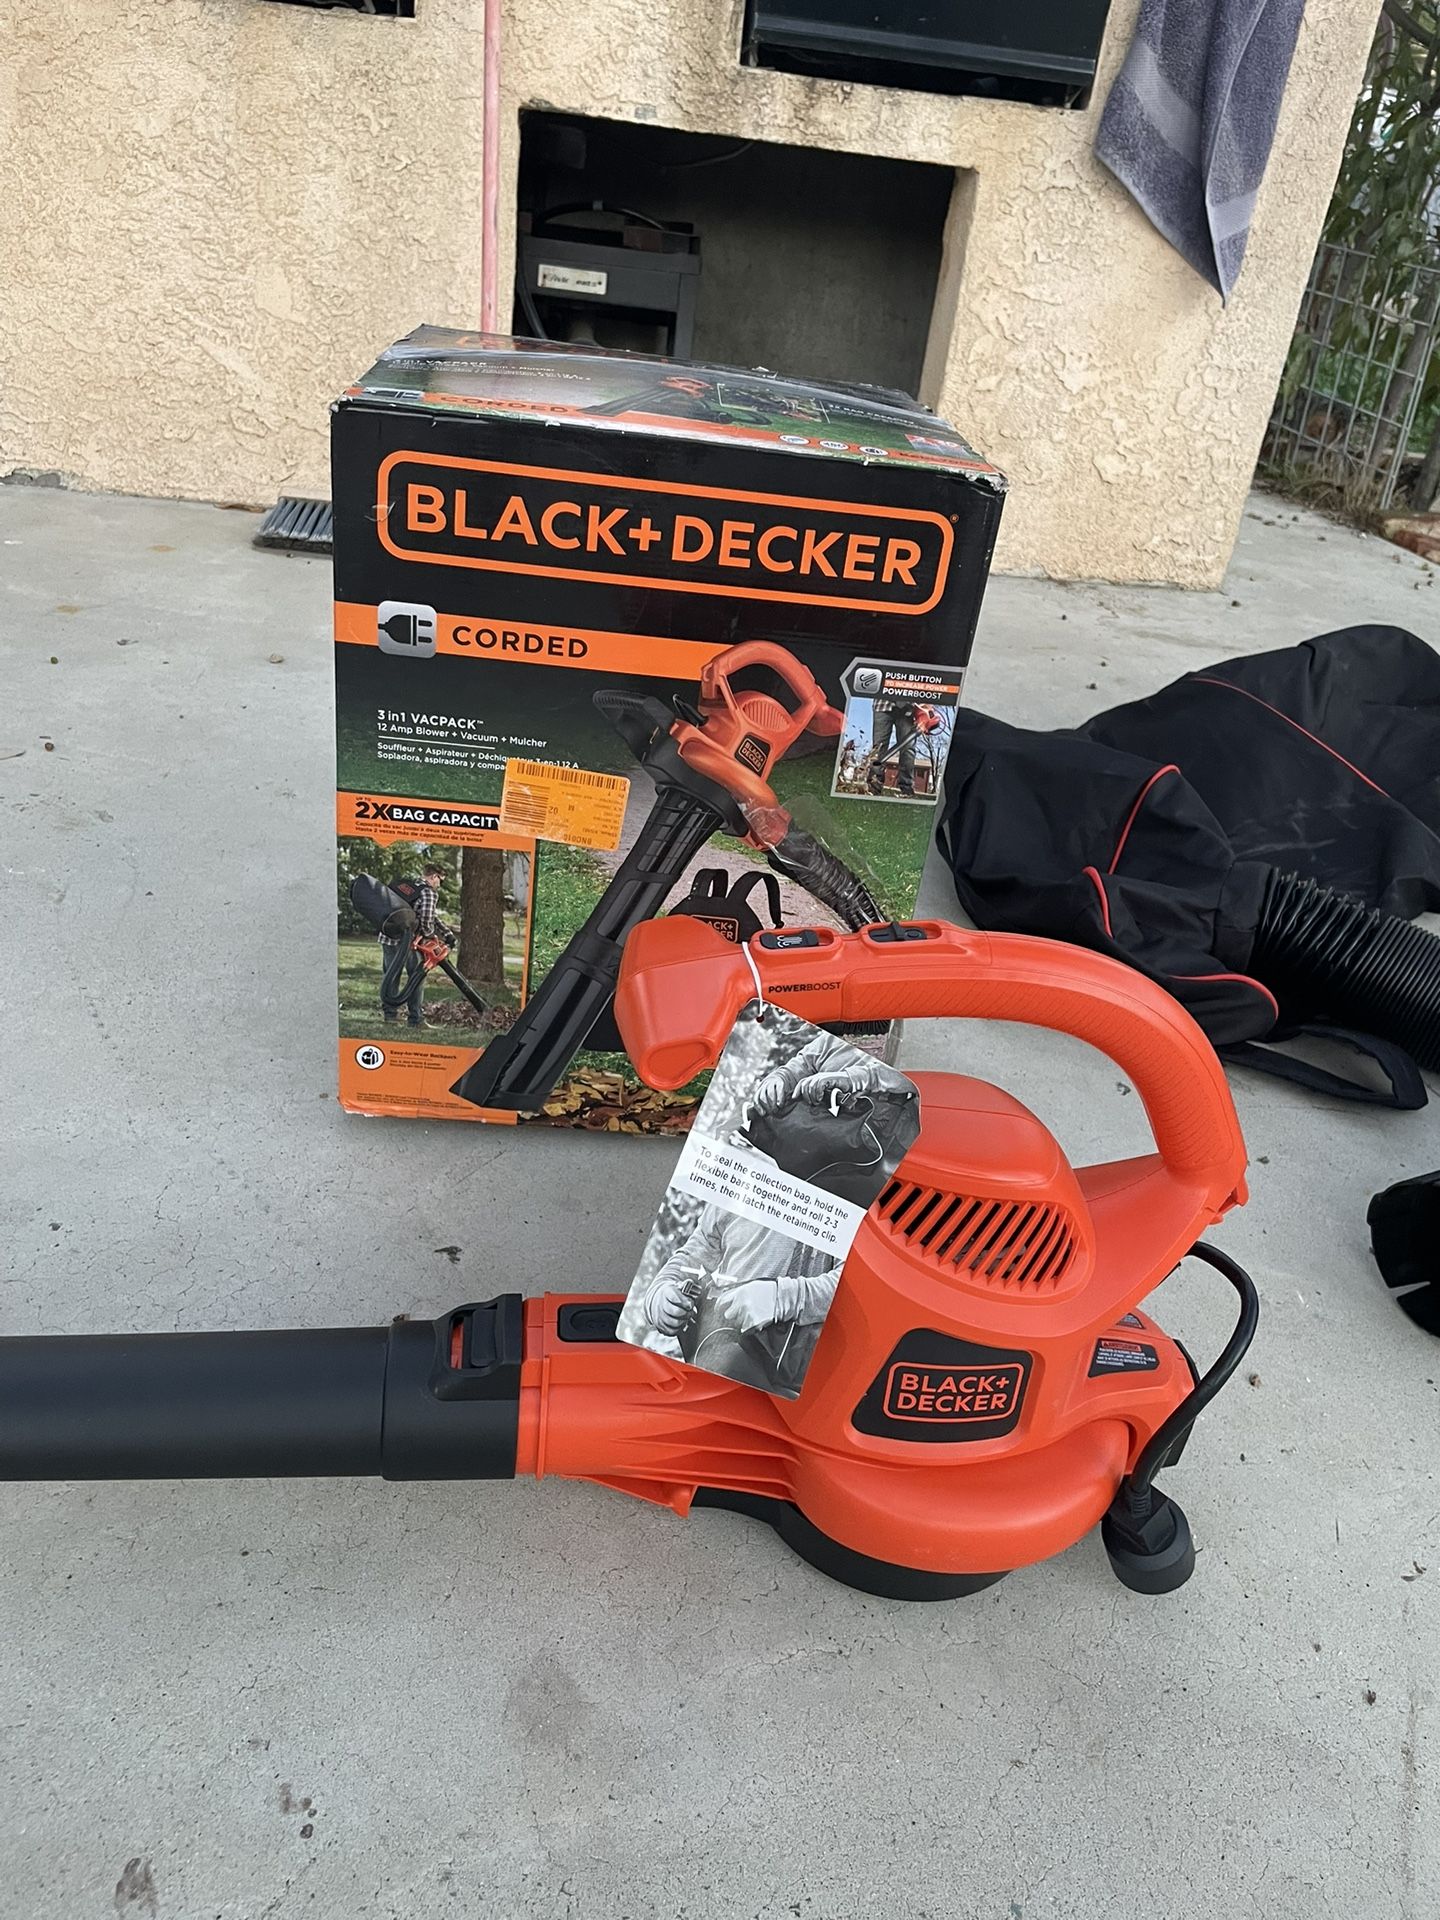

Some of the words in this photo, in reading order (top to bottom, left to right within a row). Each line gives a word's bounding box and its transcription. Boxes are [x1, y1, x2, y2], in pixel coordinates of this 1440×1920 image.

[406, 483, 922, 586] BLACK+DECKER
[452, 625, 588, 658] CORDED
[885, 672, 907, 680] PUSH
[908, 674, 942, 684] BUTTON
[882, 688, 942, 699] POWERBOOST
[377, 709, 385, 720] 3
[377, 722, 387, 732] 12
[390, 724, 413, 735] Amp
[416, 726, 449, 738] Blower
[460, 731, 498, 743] Vacuum
[509, 736, 548, 748] Mulcher
[377, 742, 416, 753] Souffleur
[425, 746, 469, 759] Aspirateur
[377, 751, 422, 764] Sopladora,
[424, 755, 468, 768] aspiradora
[469, 761, 475, 769] y
[477, 762, 507, 771] compa
[355, 801, 389, 820] 2X
[392, 808, 425, 821] BAG
[707, 921, 734, 930] ACK+
[768, 981, 842, 994] POWERBOOST
[700, 1146, 712, 1159] To
[713, 1154, 733, 1169] seal
[733, 1161, 748, 1175] the
[750, 1169, 793, 1195] collection
[794, 1188, 813, 1206] bag,
[814, 1196, 834, 1215] hold
[835, 1206, 849, 1220] the
[694, 1158, 729, 1182] flexible
[730, 1173, 751, 1191] bars
[752, 1183, 790, 1208] together
[791, 1200, 808, 1216] and
[808, 1208, 824, 1223] roll
[824, 1216, 839, 1229] 2-3
[689, 1171, 718, 1192] times,
[719, 1184, 741, 1201] then
[742, 1194, 766, 1213] latch
[767, 1204, 782, 1218] the
[782, 1212, 820, 1237] retaining
[821, 1230, 838, 1245] clip.
[900, 1373, 1010, 1393] BLACK+
[897, 1392, 1008, 1412] DECKER
